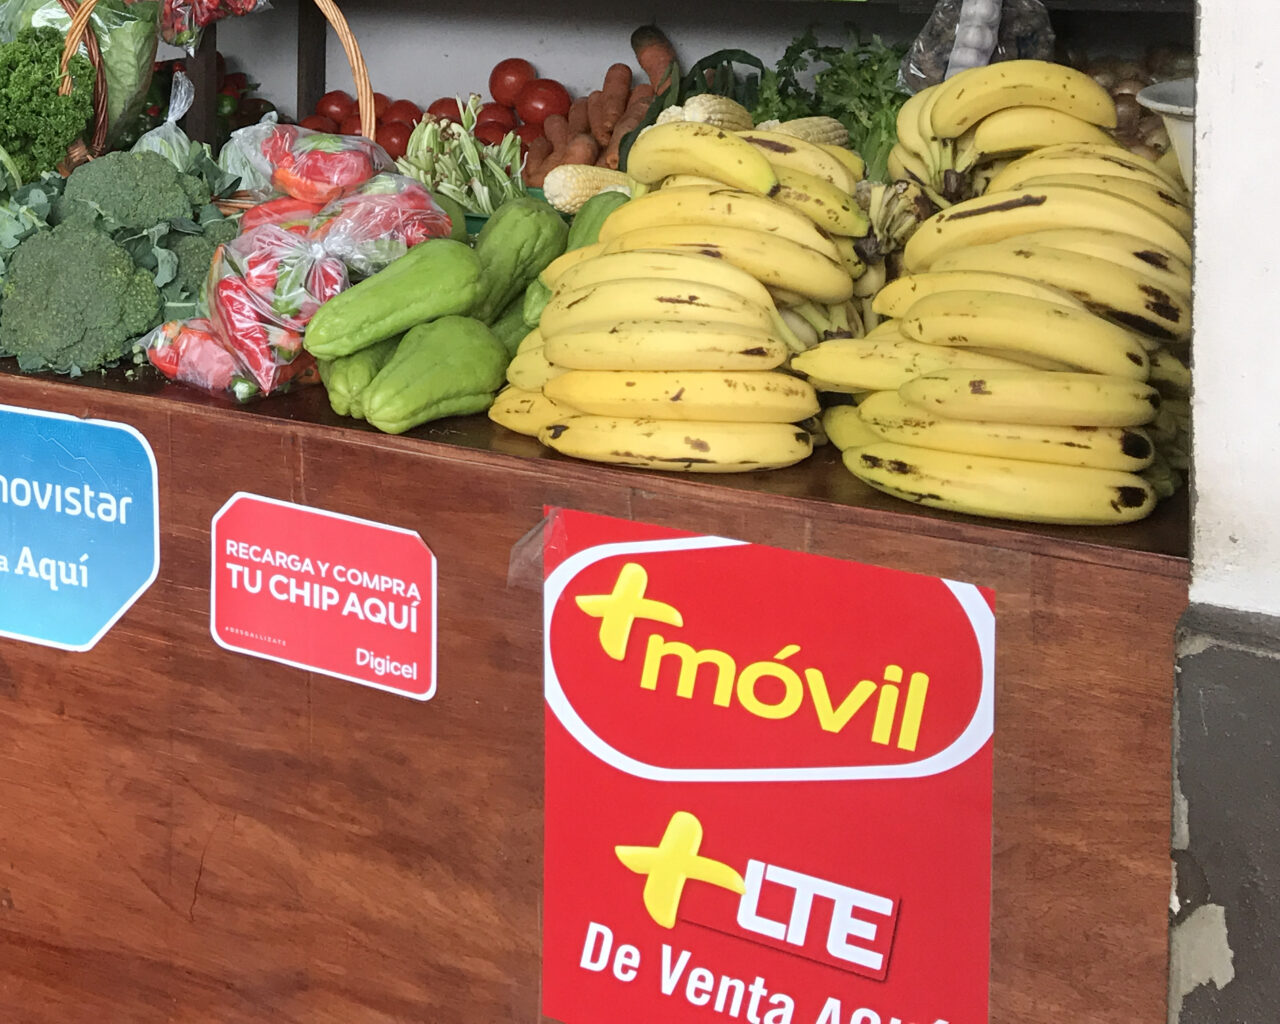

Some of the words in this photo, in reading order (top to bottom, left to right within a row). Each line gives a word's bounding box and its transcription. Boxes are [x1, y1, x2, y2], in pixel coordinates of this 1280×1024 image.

[14, 546, 90, 592] Aquí
[226, 538, 314, 576] RECARGA
[316, 560, 330, 578] Y
[332, 564, 422, 600] COMPRA
[226, 562, 264, 594] TU
[269, 574, 340, 611] CHIP
[342, 592, 420, 634] AQUÍ
[356, 648, 418, 680] Digicel
[580, 922, 642, 982] De
[660, 944, 796, 1024] Venta
